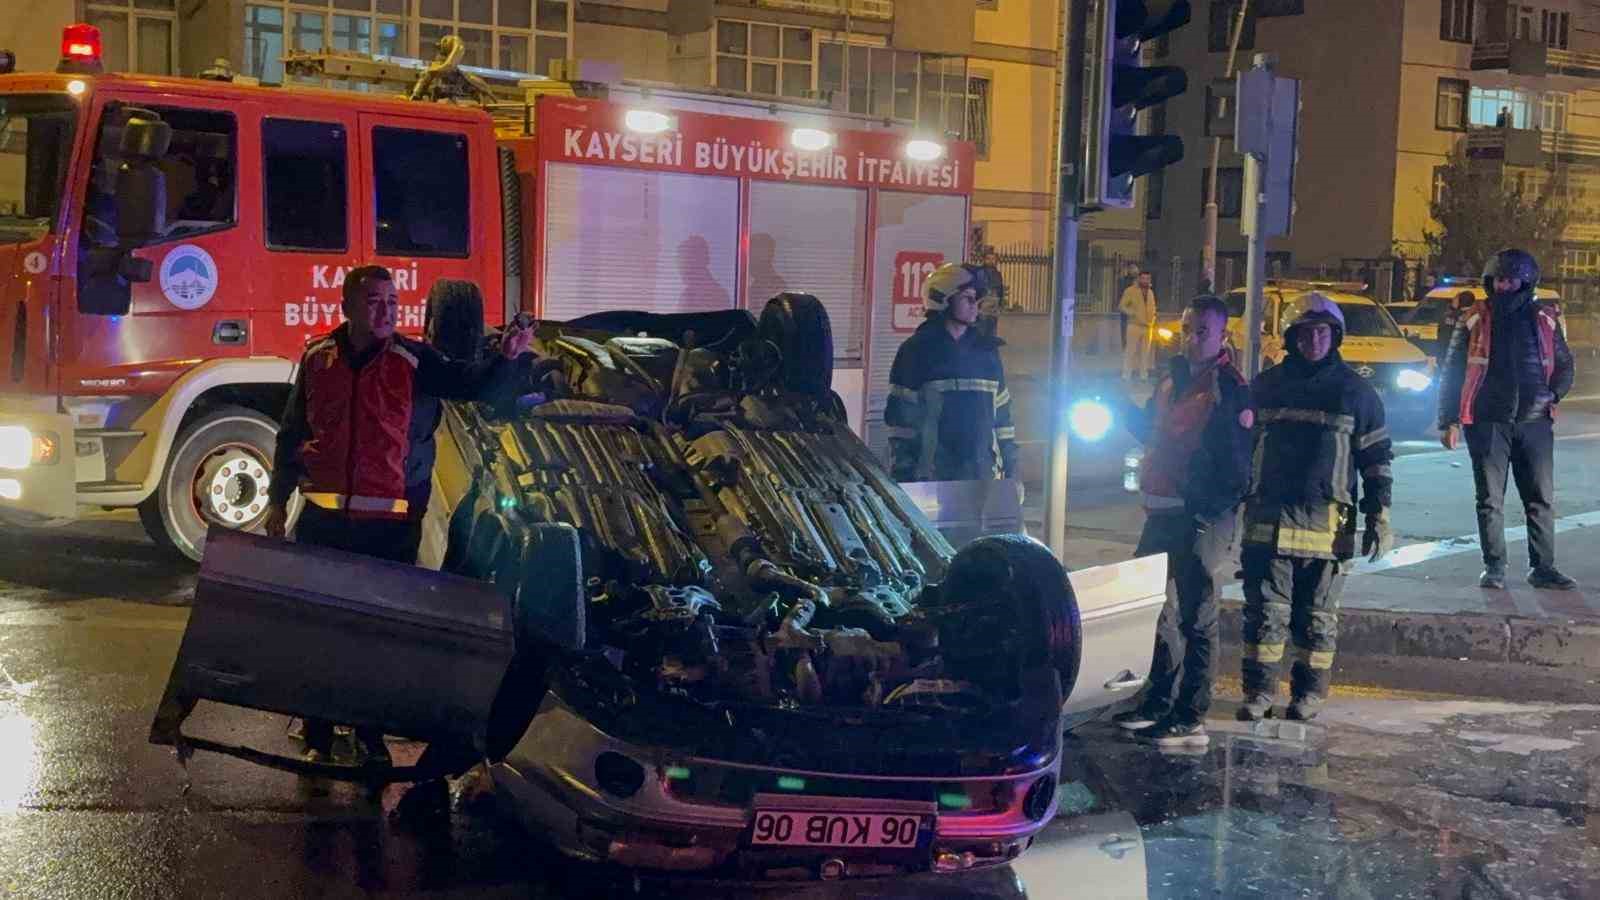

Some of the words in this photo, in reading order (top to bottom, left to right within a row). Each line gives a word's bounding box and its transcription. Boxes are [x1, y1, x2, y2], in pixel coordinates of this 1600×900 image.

[564, 128, 683, 166] KAYSERİ
[695, 137, 848, 180] BÜYÜKŞEHİR
[858, 151, 960, 188] İTFAİYESİ
[756, 814, 794, 842] 06
[805, 815, 872, 844] KUB
[881, 815, 918, 845] 06
